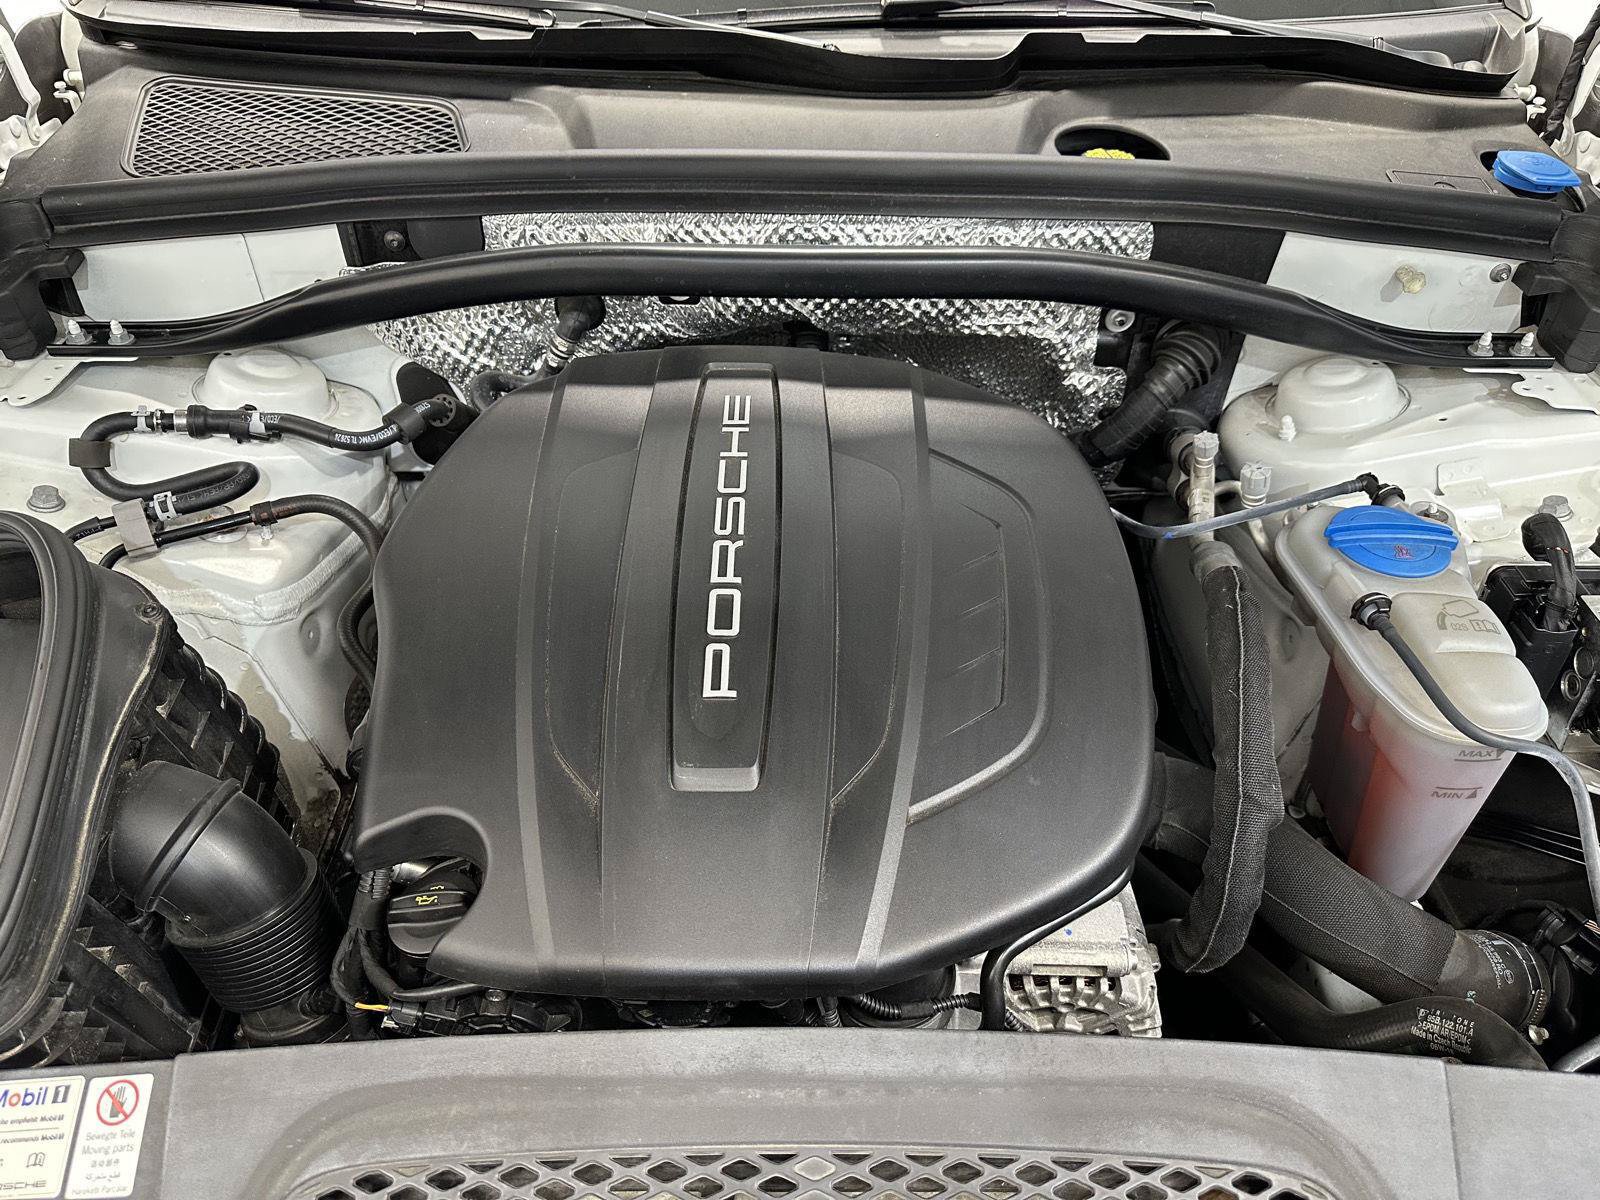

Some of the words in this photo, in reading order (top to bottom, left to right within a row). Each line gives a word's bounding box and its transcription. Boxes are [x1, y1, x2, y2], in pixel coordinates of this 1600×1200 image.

[702, 395, 751, 698] PORSCHE
[1458, 749, 1494, 758] MAX
[1430, 790, 1463, 799] MIN
[1410, 1026, 1426, 1039] Made
[82, 1145, 111, 1155] Moving
[112, 1144, 135, 1154] parts
